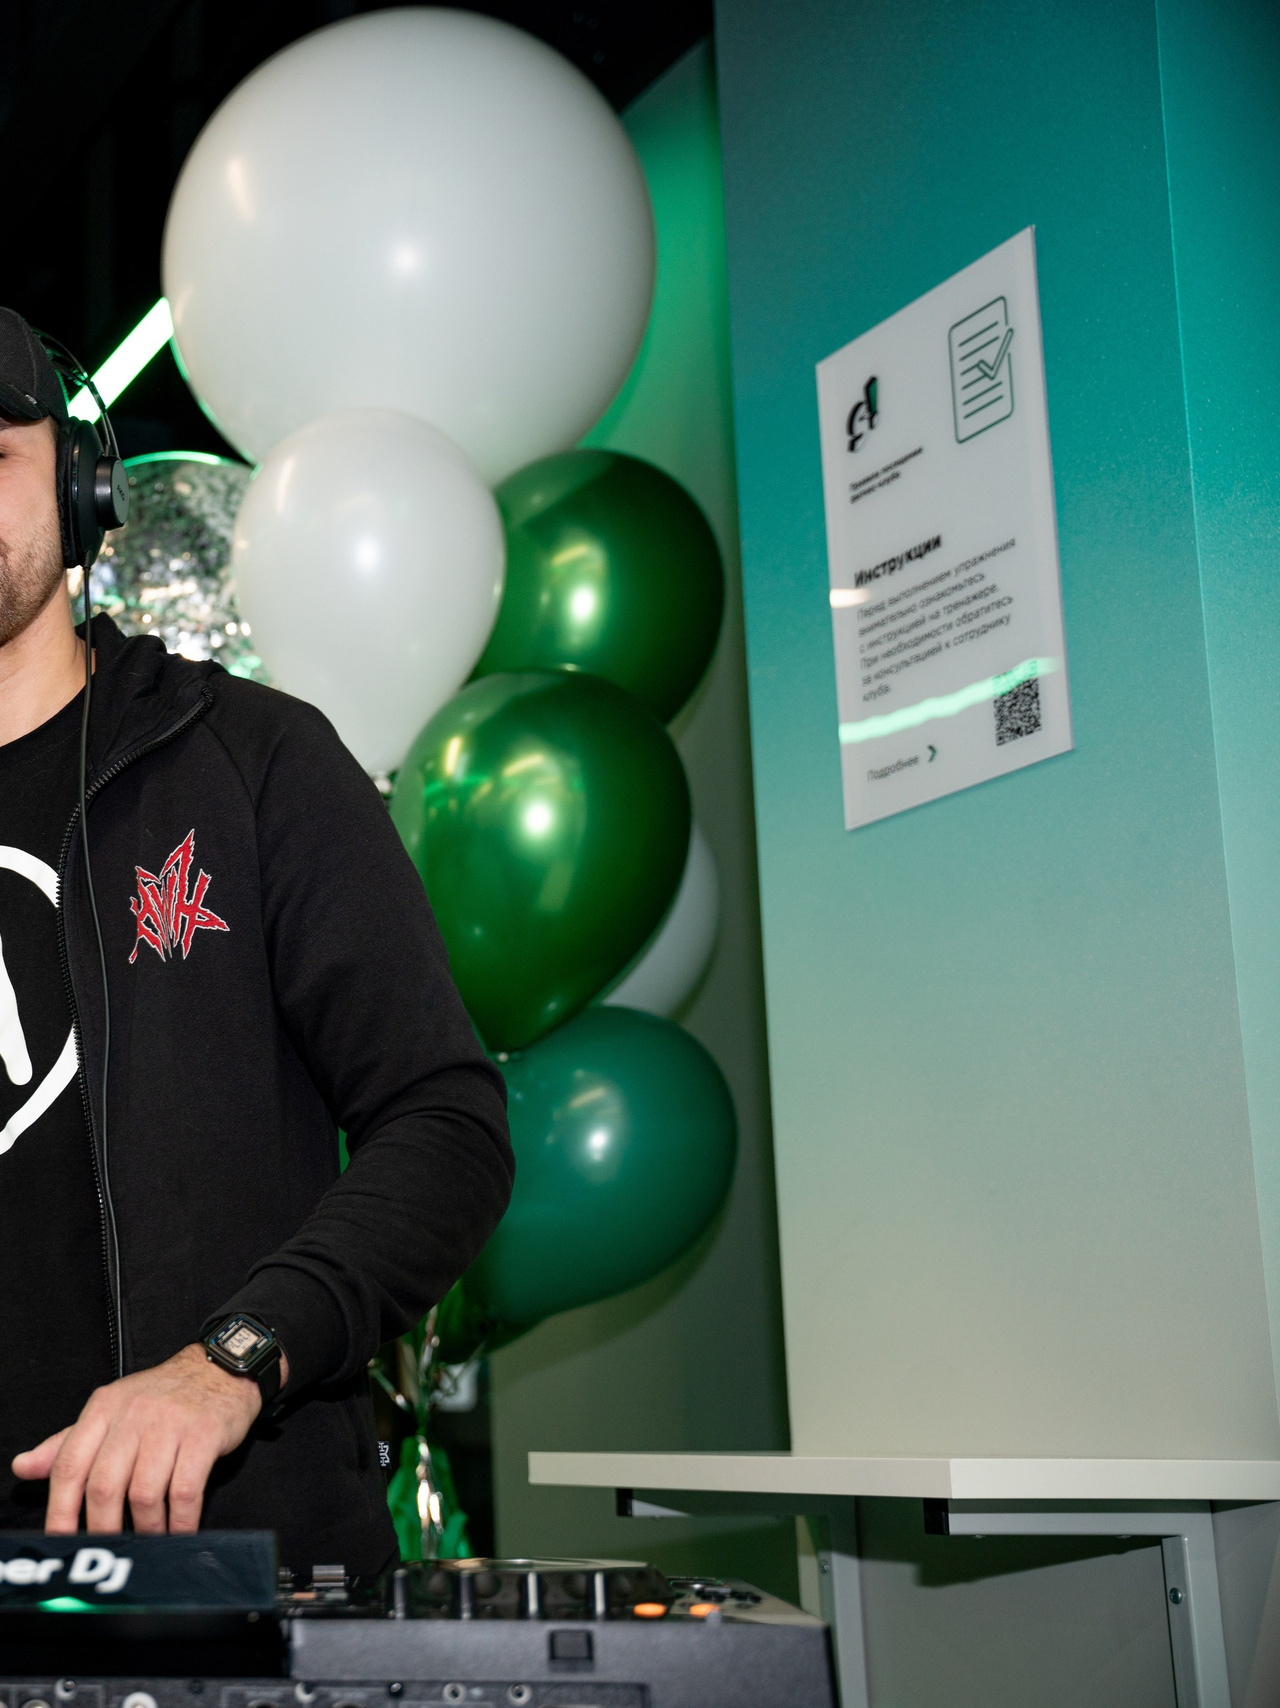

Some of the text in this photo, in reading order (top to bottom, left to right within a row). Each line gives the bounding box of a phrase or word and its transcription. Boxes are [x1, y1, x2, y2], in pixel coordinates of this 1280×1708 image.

[854, 534, 942, 588] Инструкции
[954, 537, 1016, 576] упражнения
[920, 572, 985, 607] ознакомьтесь
[861, 594, 1013, 669] При необходимости обратитесь
[867, 615, 925, 650] инструкцией
[875, 641, 942, 681] консультацией
[954, 614, 1010, 646] сотруднику
[867, 755, 919, 783] Подробнее
